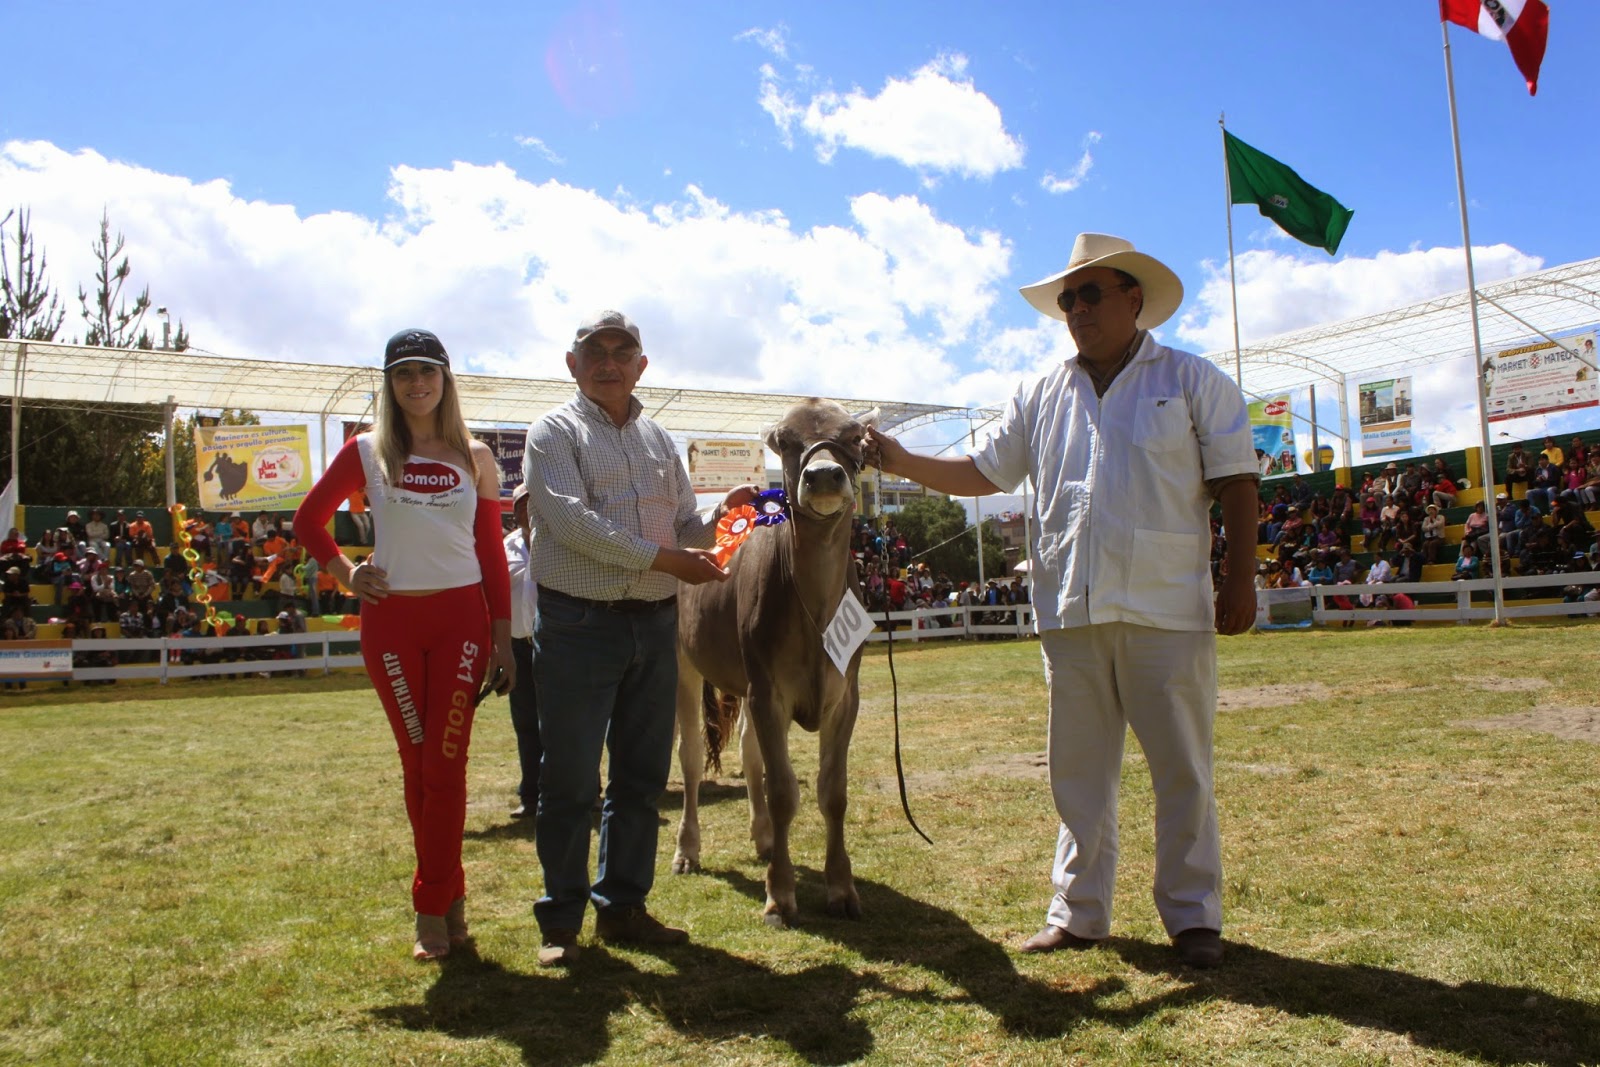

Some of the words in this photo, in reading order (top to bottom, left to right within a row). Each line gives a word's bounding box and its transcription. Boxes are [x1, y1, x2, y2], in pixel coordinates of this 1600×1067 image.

[1497, 359, 1527, 373] MARKET
[214, 433, 249, 442] Marinera
[1380, 429, 1411, 438] Ganadera
[403, 473, 455, 486] omont
[825, 600, 862, 661] 100
[382, 652, 402, 677] ATP
[442, 690, 468, 759] GOLD
